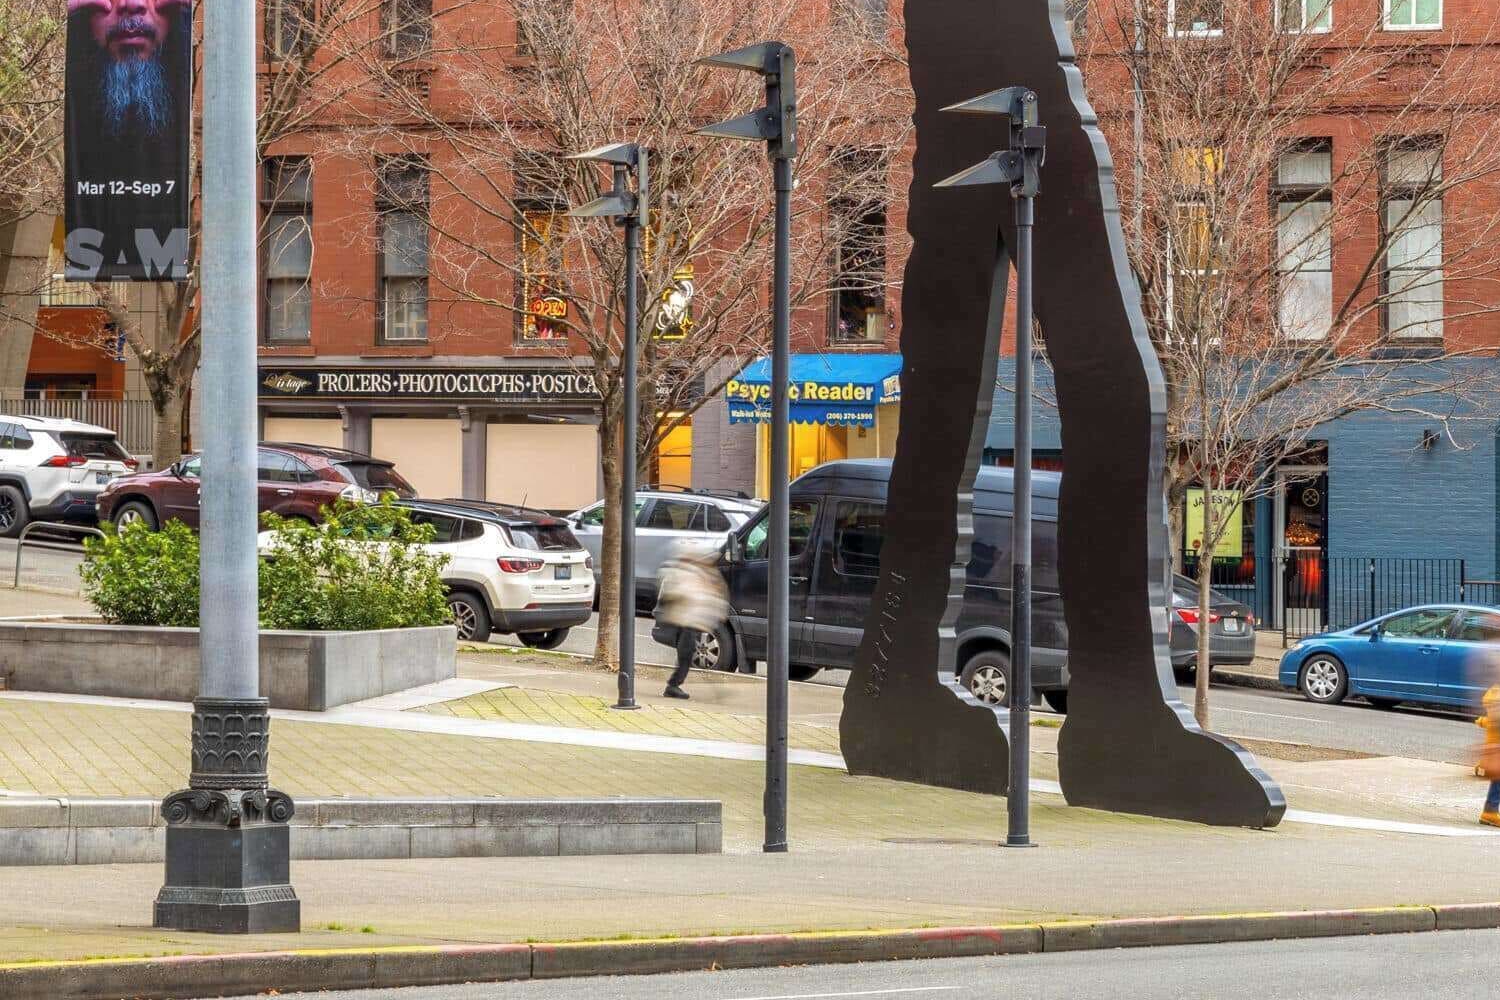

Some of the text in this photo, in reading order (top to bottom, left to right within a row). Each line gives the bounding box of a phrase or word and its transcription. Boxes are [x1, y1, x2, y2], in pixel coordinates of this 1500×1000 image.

[77, 181, 105, 195] Mar
[166, 180, 175, 195] 7
[64, 227, 188, 281] SAM
[532, 374, 600, 393] POSTCA
[727, 380, 800, 401] Psycc
[804, 382, 874, 401] Reader
[1193, 495, 1236, 508] JAESON
